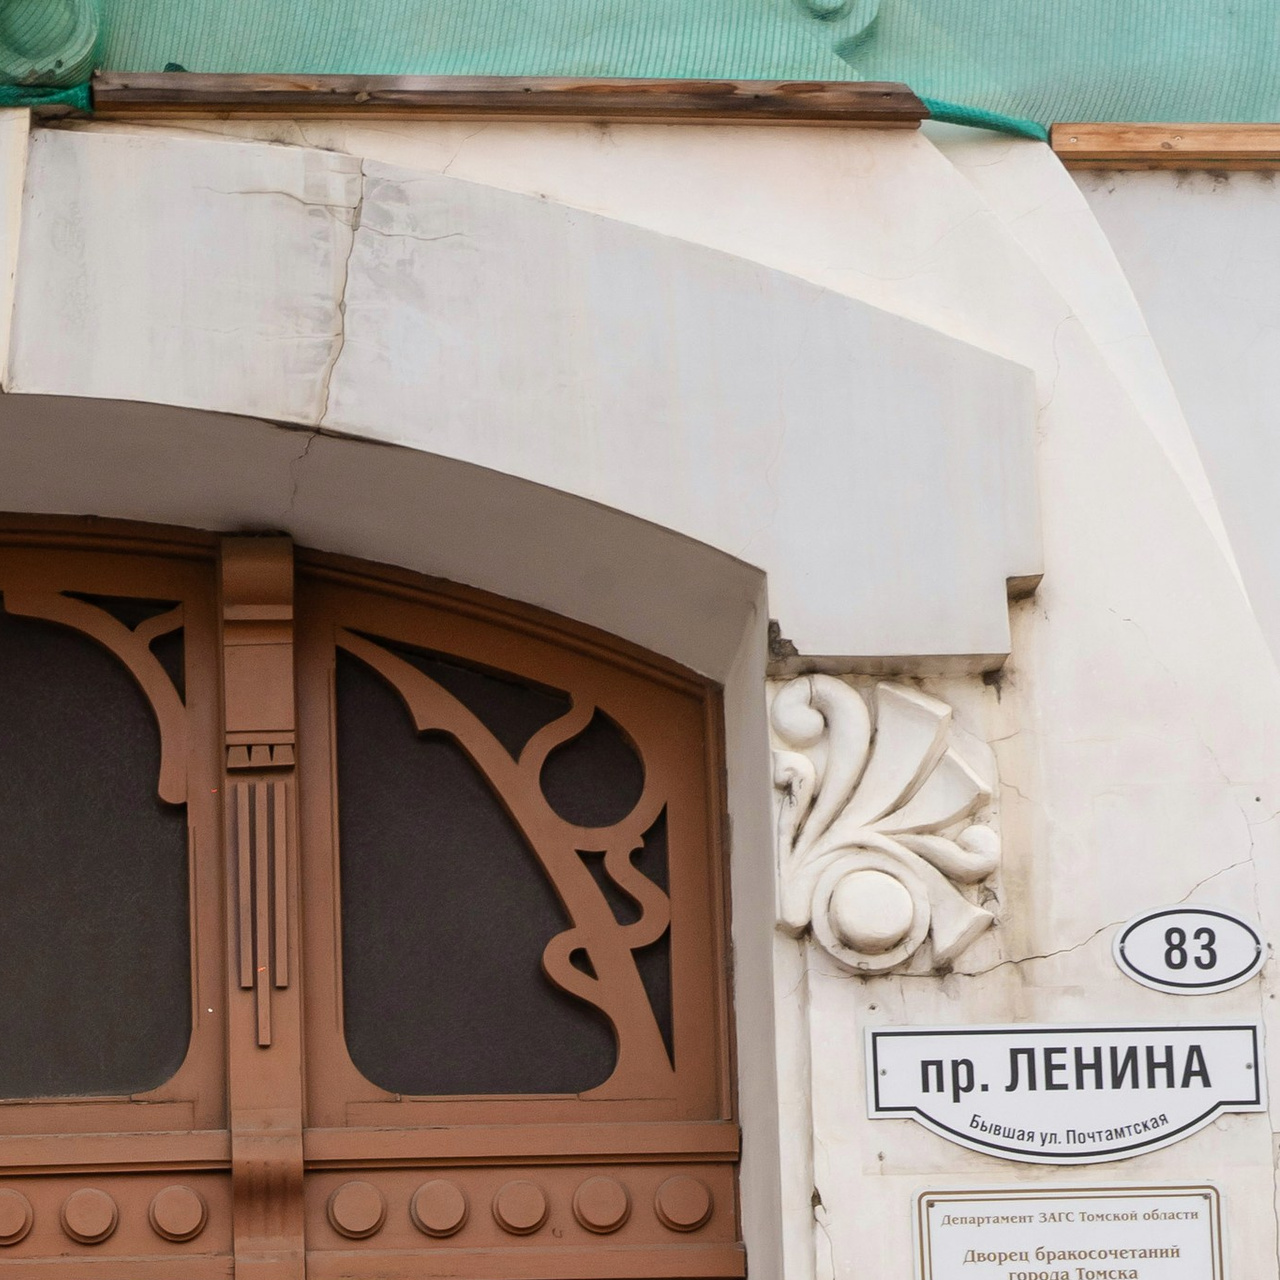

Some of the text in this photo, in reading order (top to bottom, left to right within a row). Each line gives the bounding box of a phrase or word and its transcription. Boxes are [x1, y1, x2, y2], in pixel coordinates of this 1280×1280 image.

[1165, 927, 1217, 970] 83
[921, 1045, 1211, 1103] пр. ЛЕНИНА
[969, 1114, 1169, 1146] Бывшая ул. Почтамтская
[942, 1209, 1198, 1227] Департамент ЗАГС Томской области
[963, 1245, 1179, 1265] Дворец бракосочетаний
[1076, 1268, 1138, 1280] Томска
